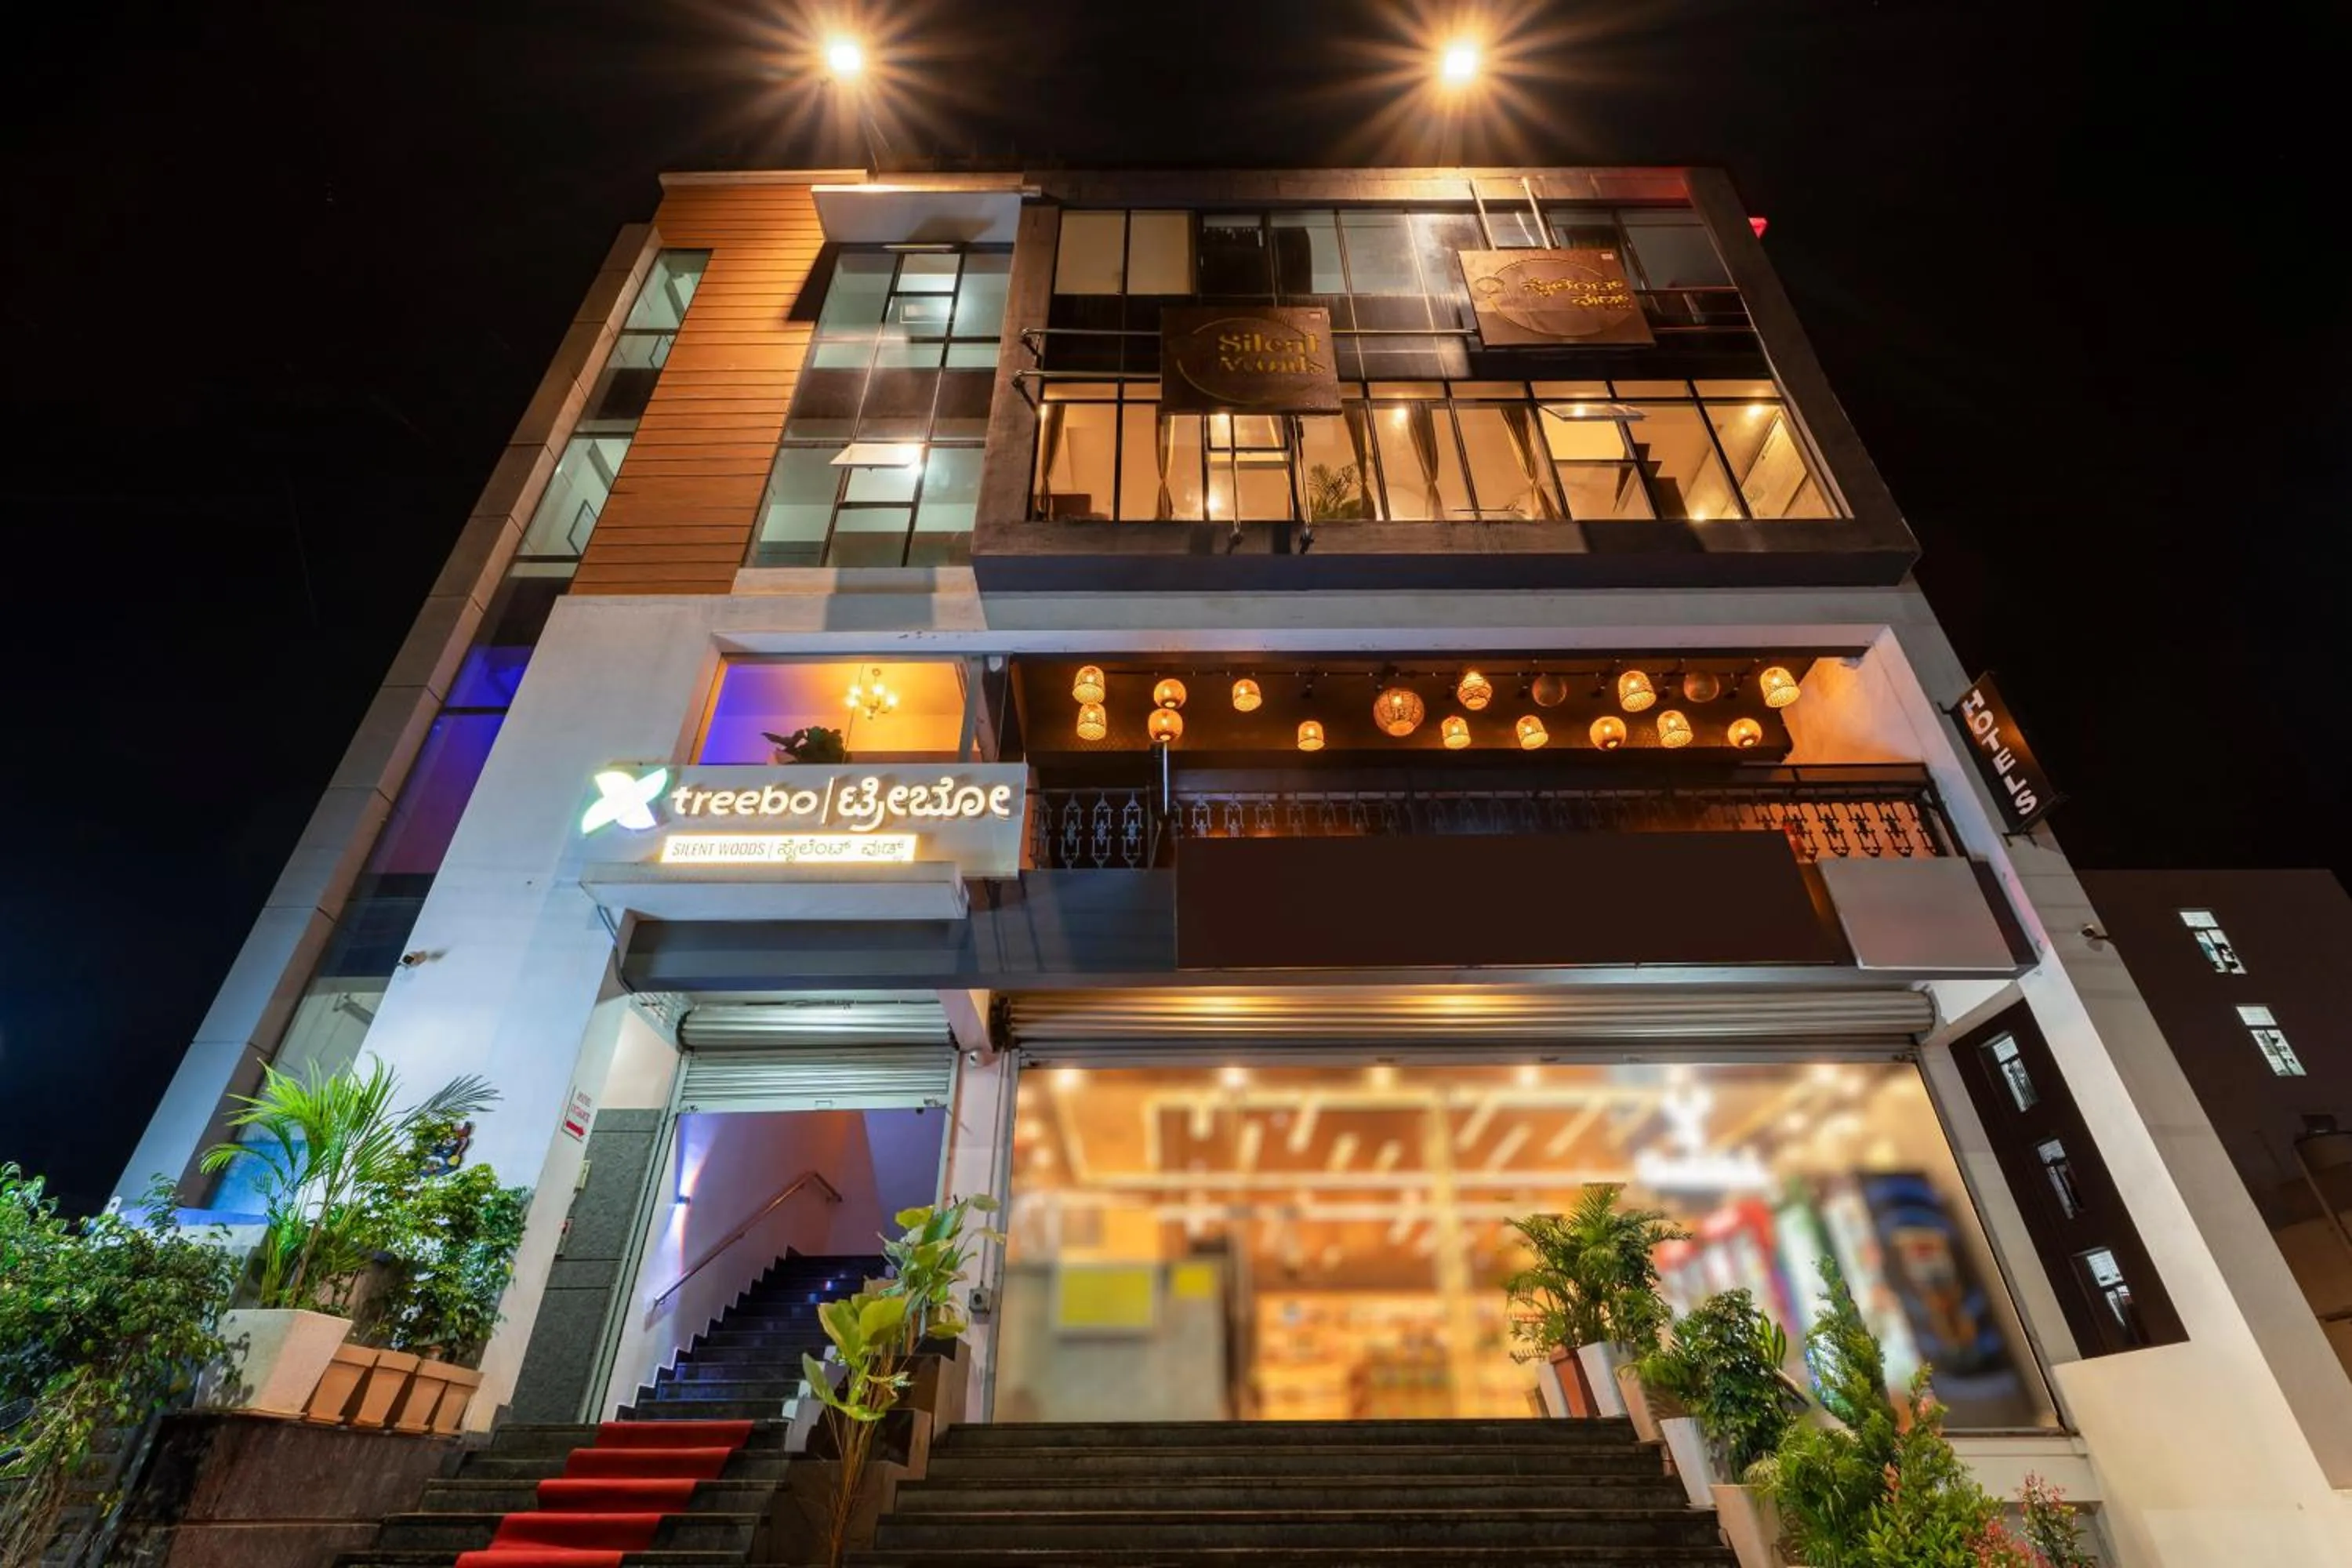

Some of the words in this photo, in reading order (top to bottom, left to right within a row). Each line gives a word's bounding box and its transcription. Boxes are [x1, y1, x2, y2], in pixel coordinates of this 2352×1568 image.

[1962, 689, 2038, 815] HOTELS
[671, 786, 818, 815] treebo
[672, 842, 715, 856] SILENT
[719, 842, 766, 855] WOODS
